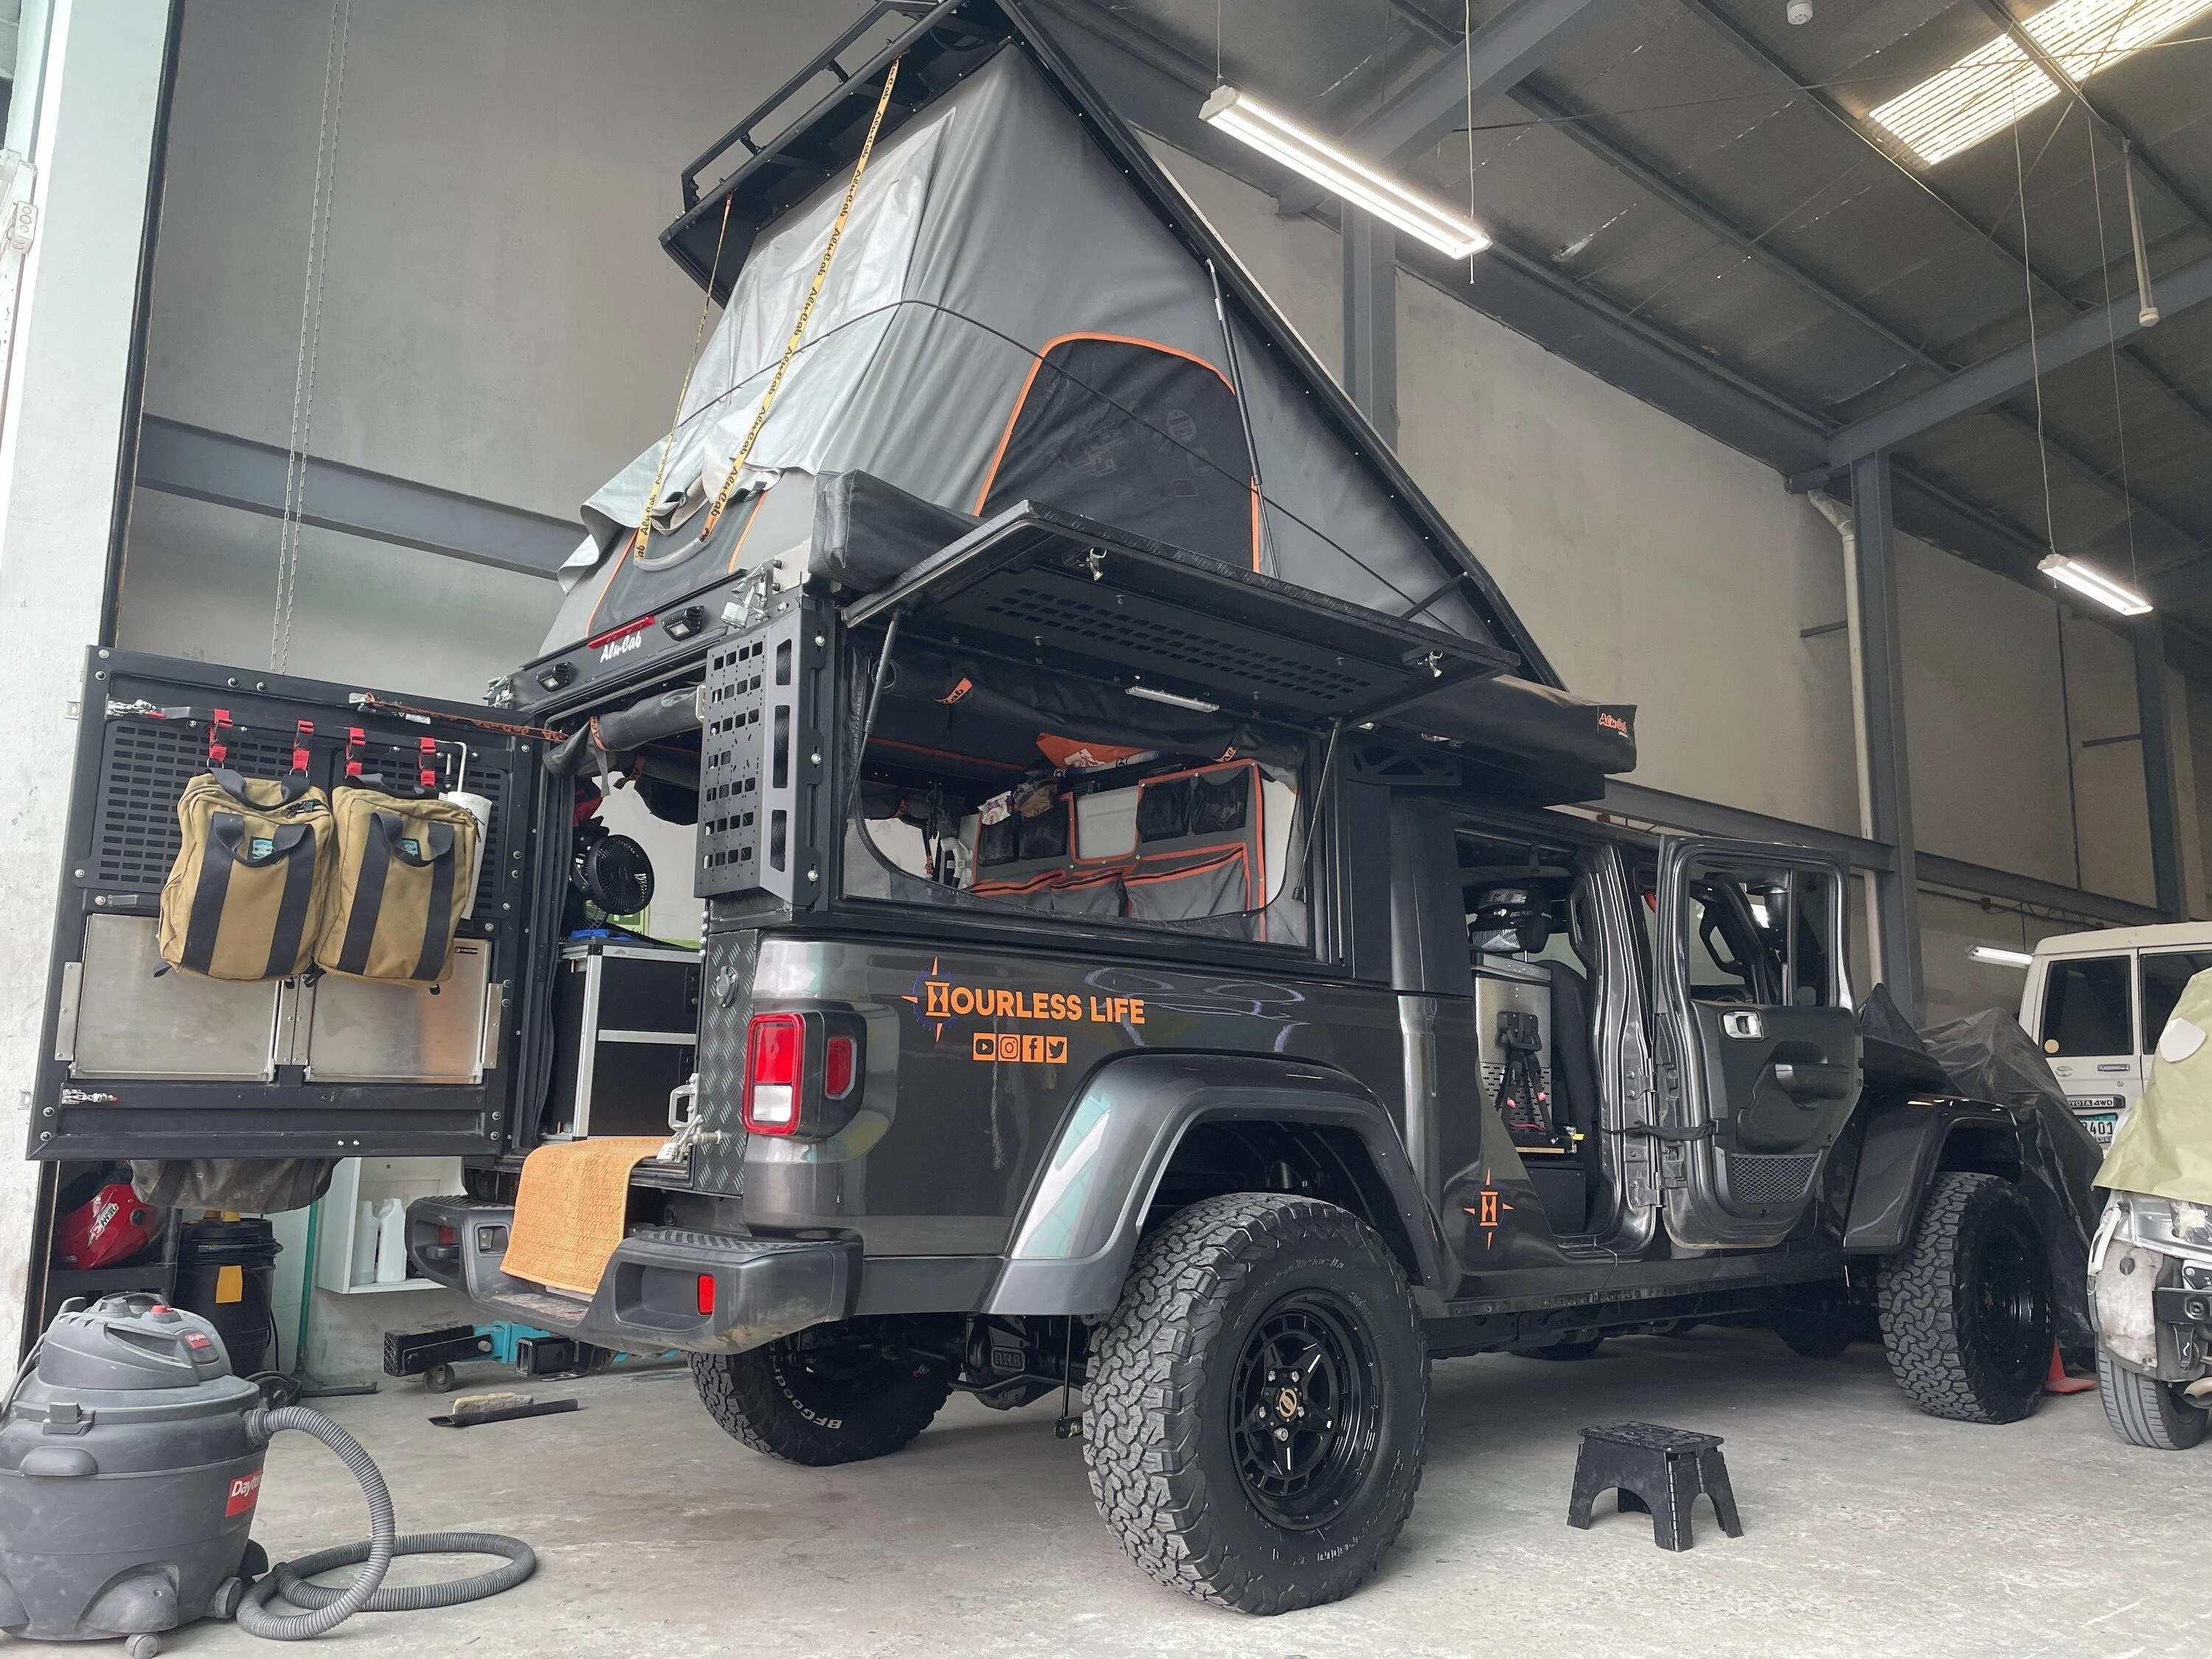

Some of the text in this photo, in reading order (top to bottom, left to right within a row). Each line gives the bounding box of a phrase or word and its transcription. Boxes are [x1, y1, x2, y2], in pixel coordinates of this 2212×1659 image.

[840, 170, 861, 217] Alu-Cab
[818, 228, 841, 276] Alu-Cab
[794, 286, 818, 336] Alu-Cab
[768, 346, 793, 395] Alu-Cab
[740, 406, 766, 455] Alu-Cab
[711, 466, 738, 517] Alu-Cab
[599, 630, 642, 663] Alu-Cab
[1090, 995, 1146, 1024] LIFE
